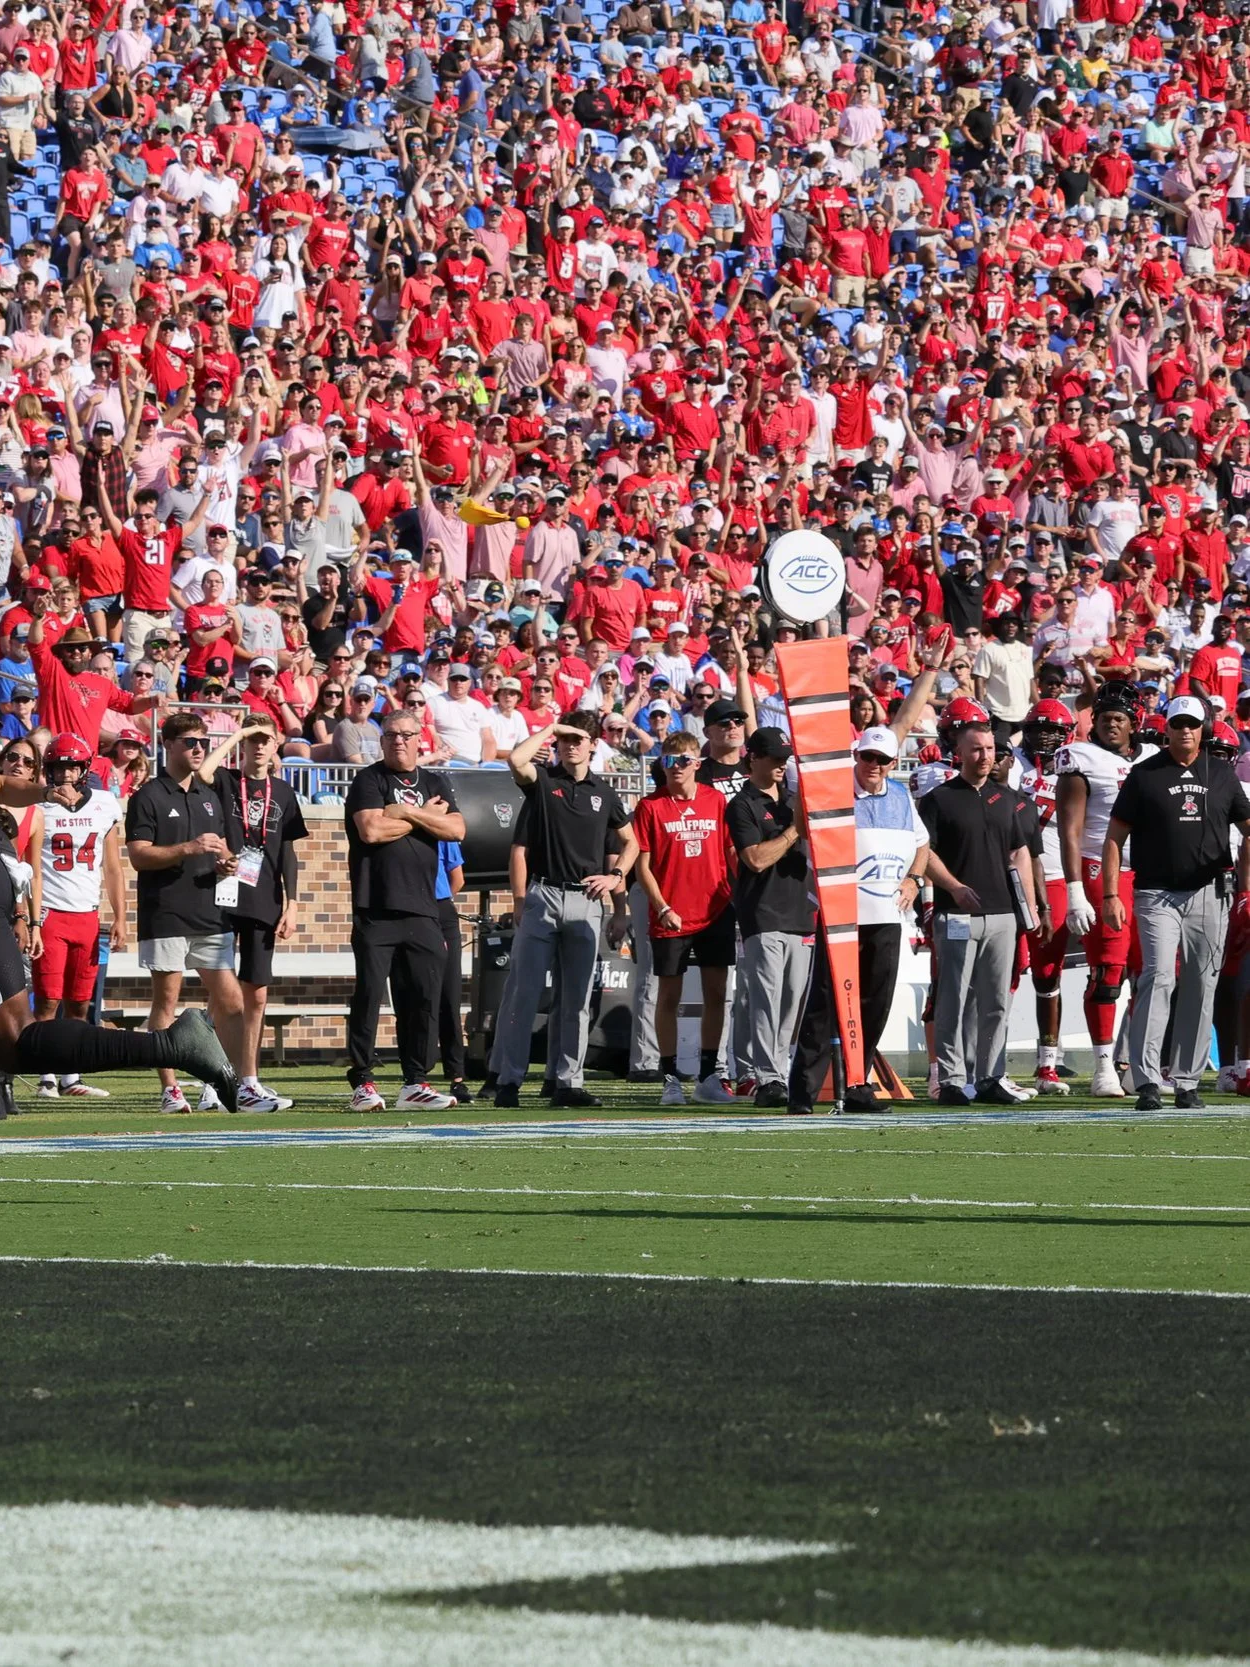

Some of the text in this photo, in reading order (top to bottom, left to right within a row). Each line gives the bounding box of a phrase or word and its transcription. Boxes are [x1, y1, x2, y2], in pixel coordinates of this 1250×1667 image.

[987, 302, 1006, 319] 87
[145, 539, 165, 565] 21
[789, 564, 830, 579] ACC
[1168, 784, 1208, 796] NC STATE
[55, 817, 93, 828] NC STATE
[664, 818, 717, 833] WOLFPACK
[51, 832, 98, 872] 94
[843, 978, 857, 1049] Gilman
